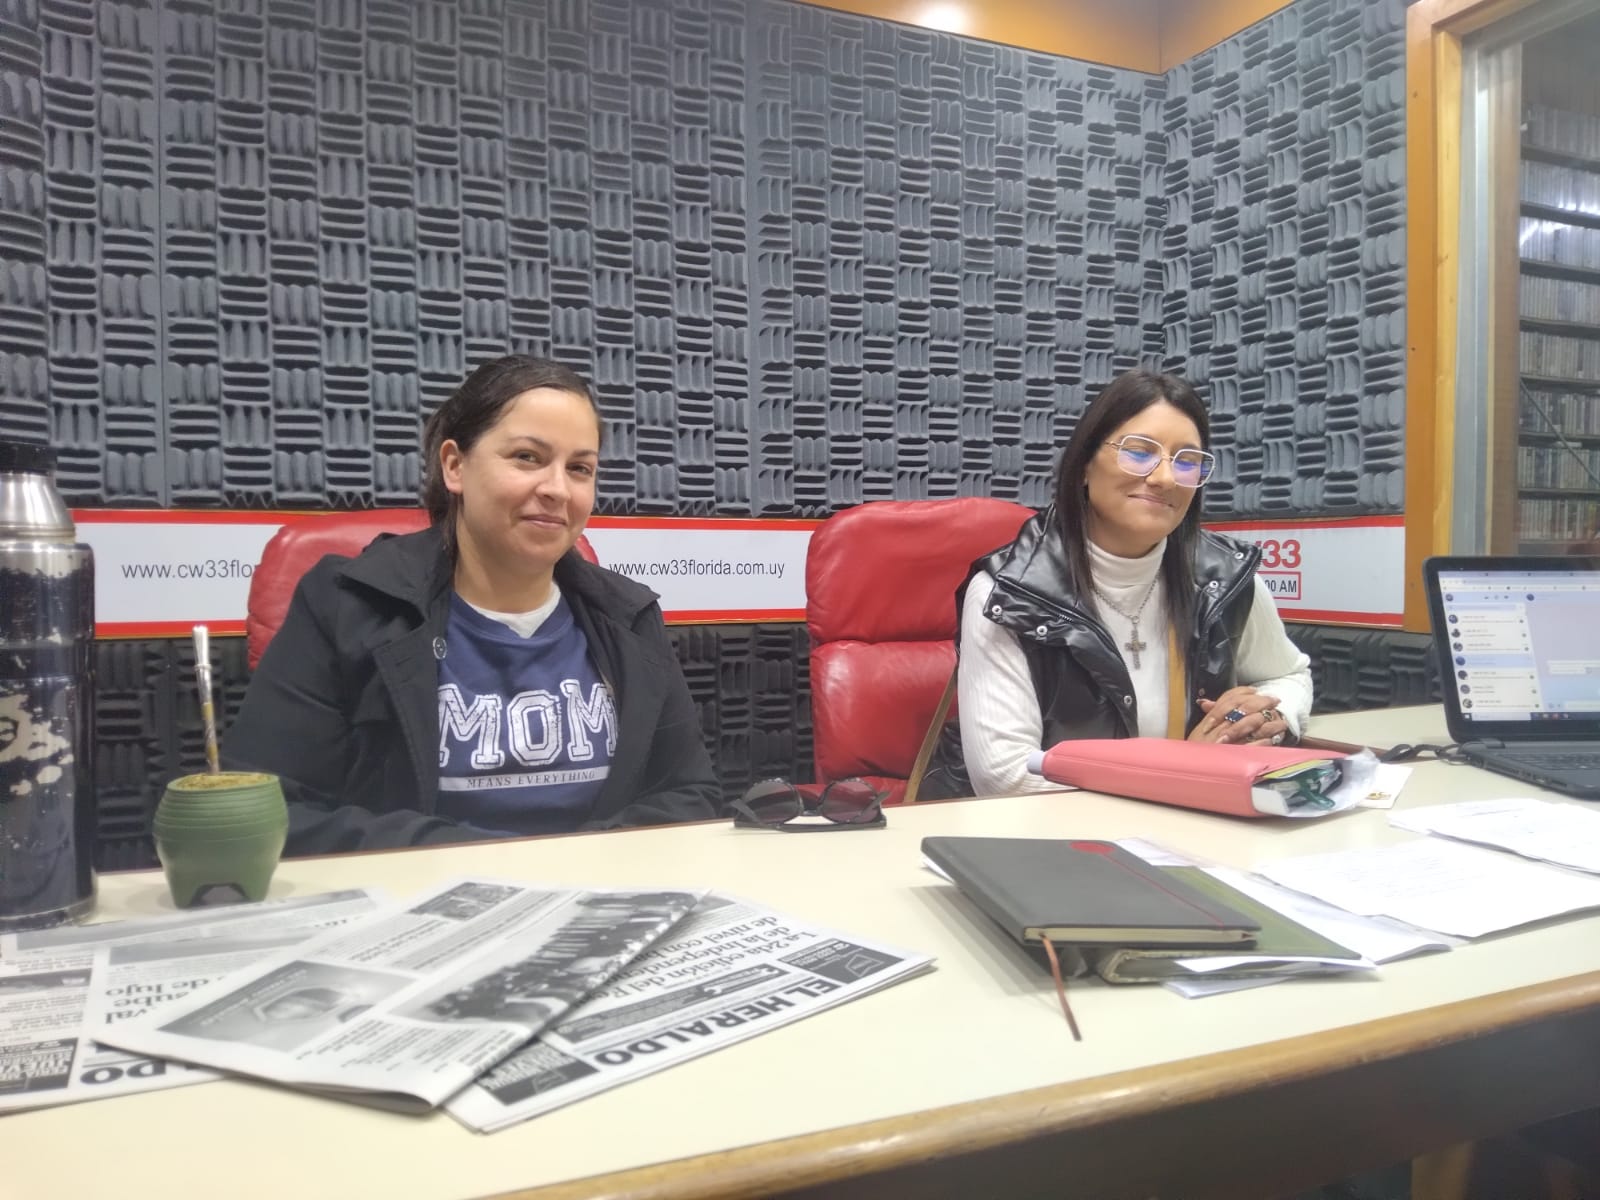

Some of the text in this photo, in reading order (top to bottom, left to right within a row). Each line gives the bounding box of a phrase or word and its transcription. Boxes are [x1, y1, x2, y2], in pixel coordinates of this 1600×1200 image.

[1255, 539, 1301, 568] 33
[609, 559, 785, 578] www.cw33florida.com.uy
[1279, 580, 1297, 593] AM
[438, 679, 618, 769] MOM
[466, 770, 596, 789] MEANS EVERYTHING
[751, 917, 777, 926] de
[763, 927, 790, 937] de
[785, 978, 841, 996] EL
[593, 993, 796, 1067] HERALDO
[80, 1060, 186, 1085] DO
